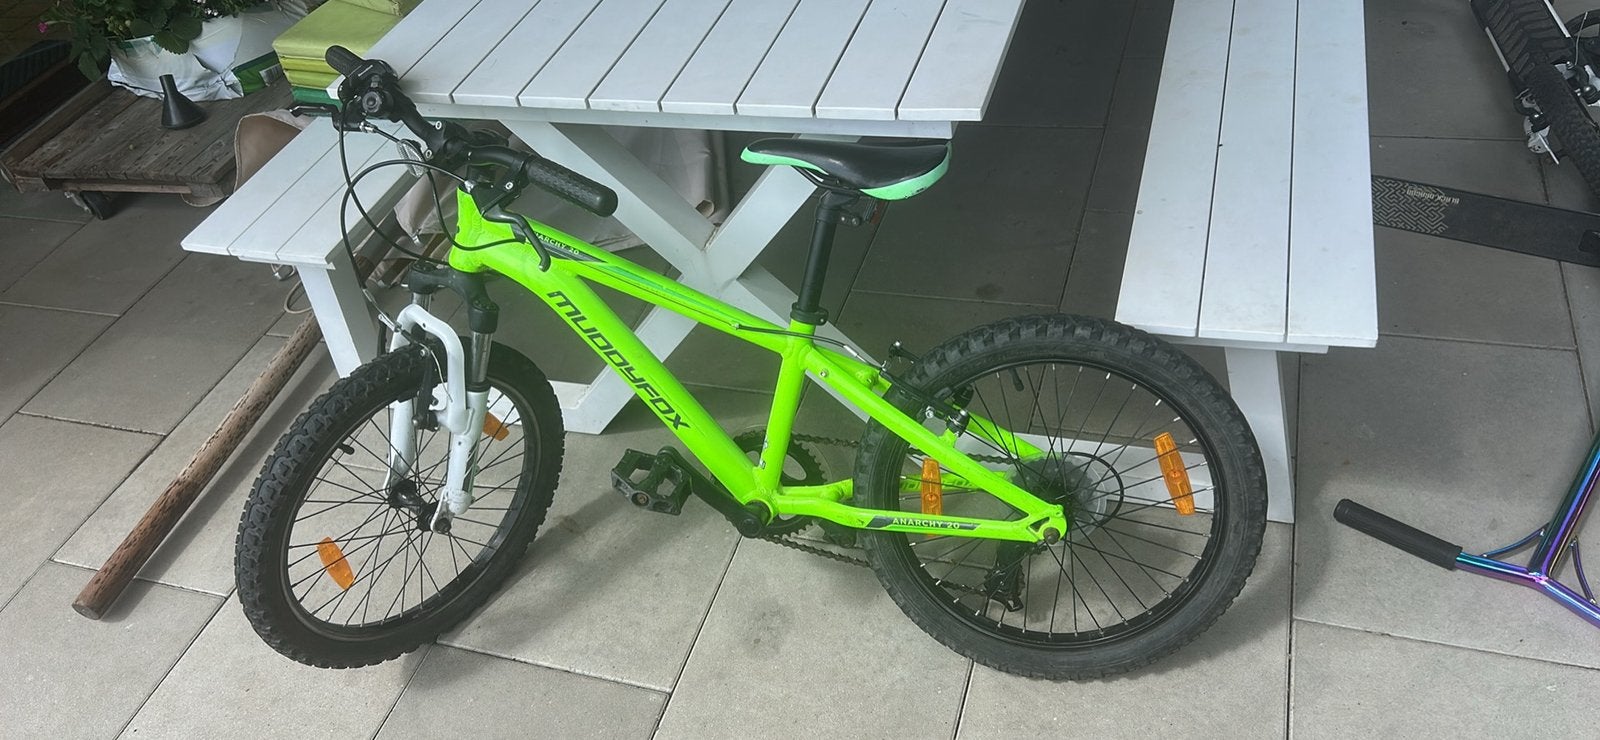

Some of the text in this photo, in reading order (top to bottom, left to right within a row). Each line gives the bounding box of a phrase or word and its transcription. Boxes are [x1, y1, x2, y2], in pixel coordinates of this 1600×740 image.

[547, 290, 690, 430] MUDDYFOX
[892, 517, 960, 530] ANARCHY 20
